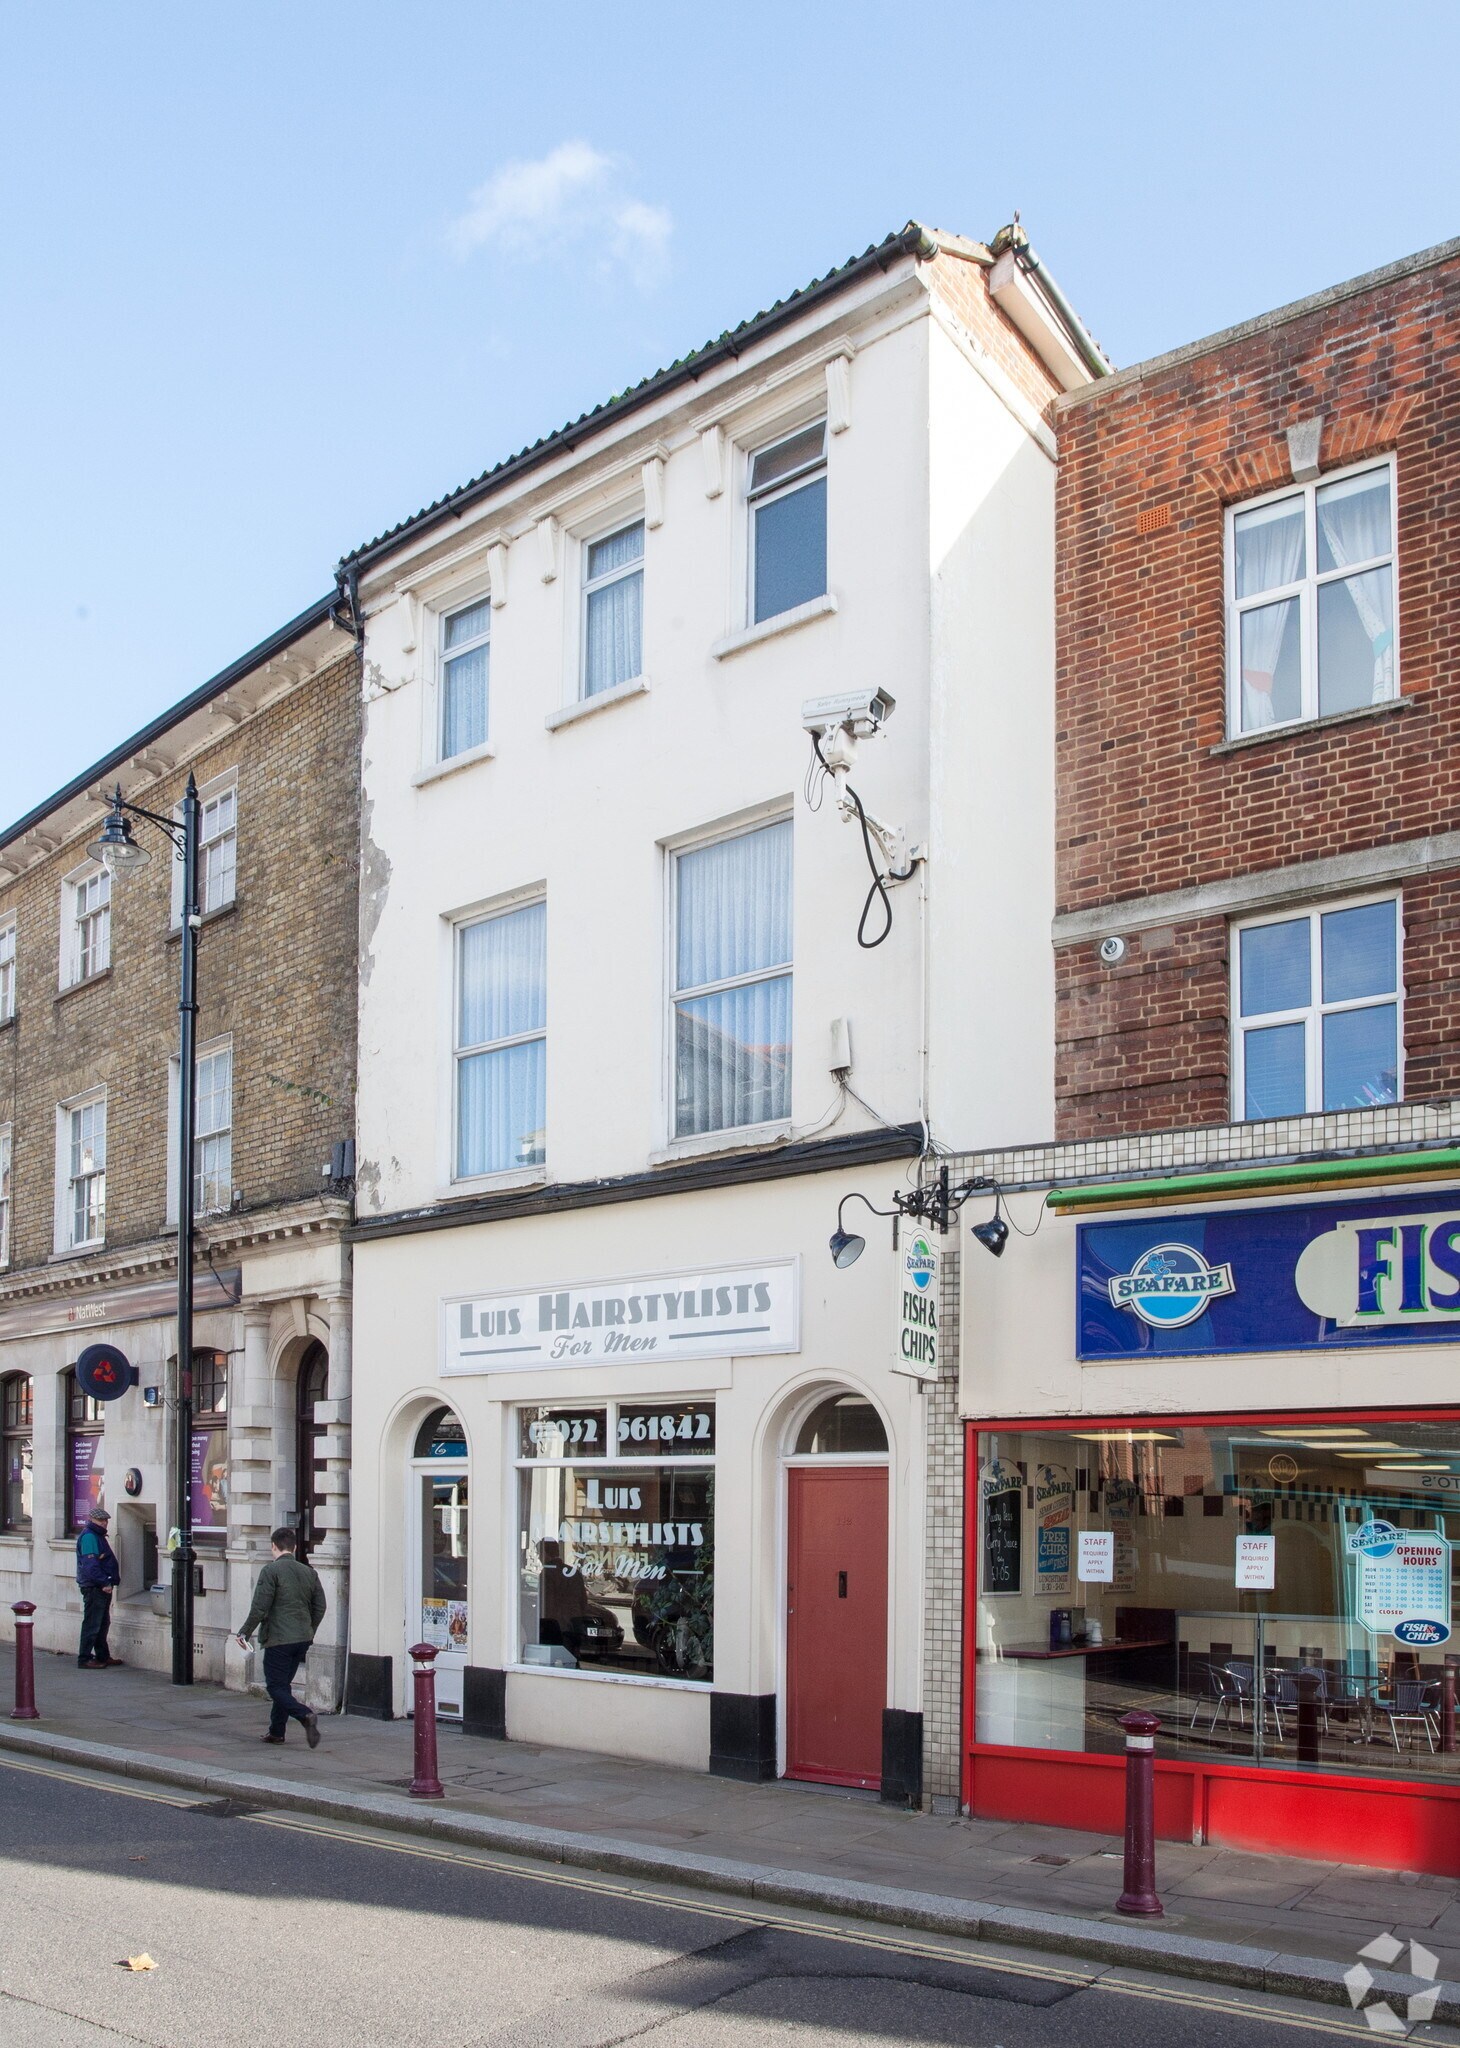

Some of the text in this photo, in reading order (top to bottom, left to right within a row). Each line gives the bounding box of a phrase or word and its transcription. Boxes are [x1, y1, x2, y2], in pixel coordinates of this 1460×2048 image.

[906, 1255, 936, 1271] SEAFARE
[1117, 1272, 1223, 1297] SEAFARE
[76, 1302, 106, 1320] NatWest
[460, 1282, 771, 1339] LUIS HAIRSTYLISTS
[903, 1290, 938, 1330] FISH &
[550, 1331, 657, 1359] For Men
[901, 1327, 936, 1365] CHIPS
[617, 1413, 711, 1442] 561842
[586, 1479, 642, 1510] LUIS
[983, 1476, 1022, 1497] SEAFARE
[1036, 1483, 1073, 1502] SEAFARE
[1042, 1531, 1066, 1543] FREE
[1084, 1538, 1107, 1546] STAFF
[1242, 1542, 1268, 1550] STAFF
[1351, 1532, 1404, 1549] SEAFARE
[1040, 1544, 1067, 1556] CHIPS
[1397, 1547, 1442, 1556] OPENING
[562, 1552, 667, 1581] For Men
[1403, 1557, 1437, 1566] HOURS
[1402, 1623, 1428, 1632] FISH
[1406, 1631, 1440, 1641] CHIPS
